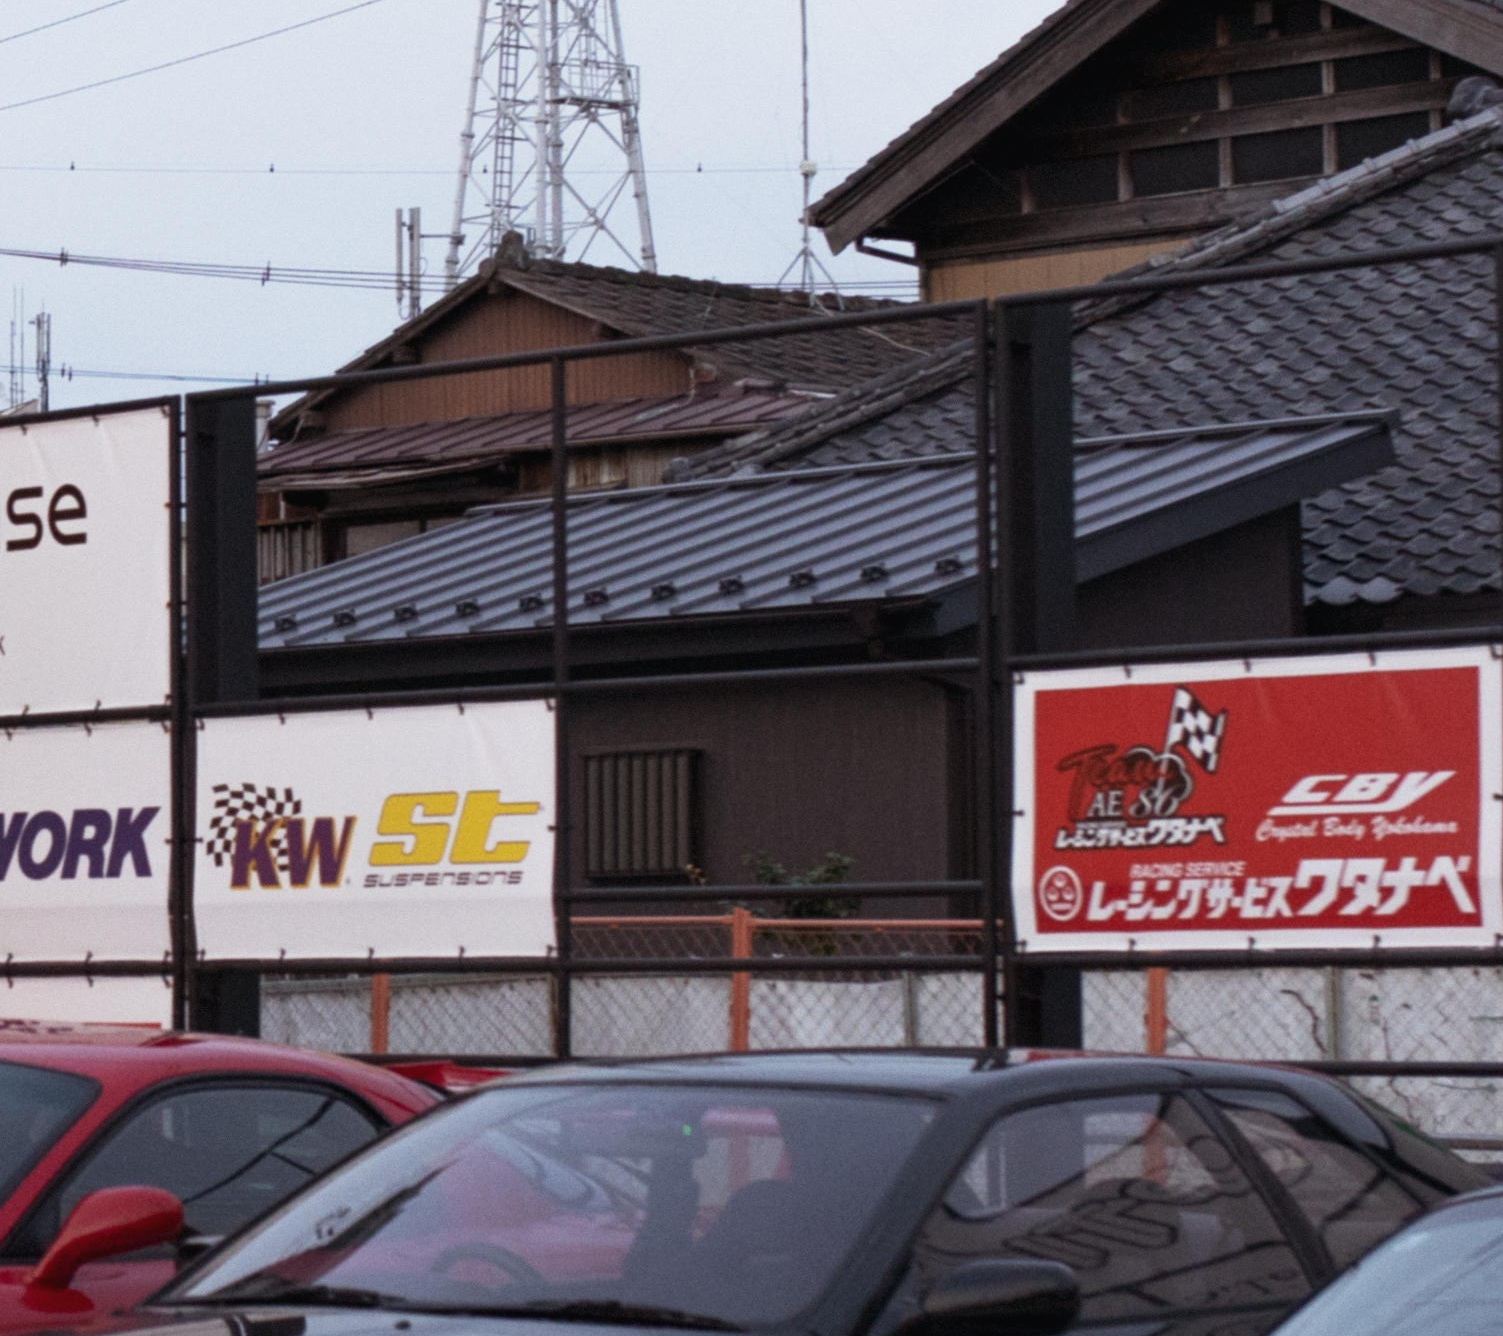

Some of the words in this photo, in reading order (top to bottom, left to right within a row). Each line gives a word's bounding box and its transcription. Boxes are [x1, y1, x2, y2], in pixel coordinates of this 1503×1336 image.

[1086, 789, 1124, 818] AE
[1322, 816, 1366, 842] Body
[1370, 814, 1459, 842] Yokohama
[230, 814, 358, 891] KW
[1129, 864, 1183, 879] RACING
[1185, 861, 1246, 877] SERVICE
